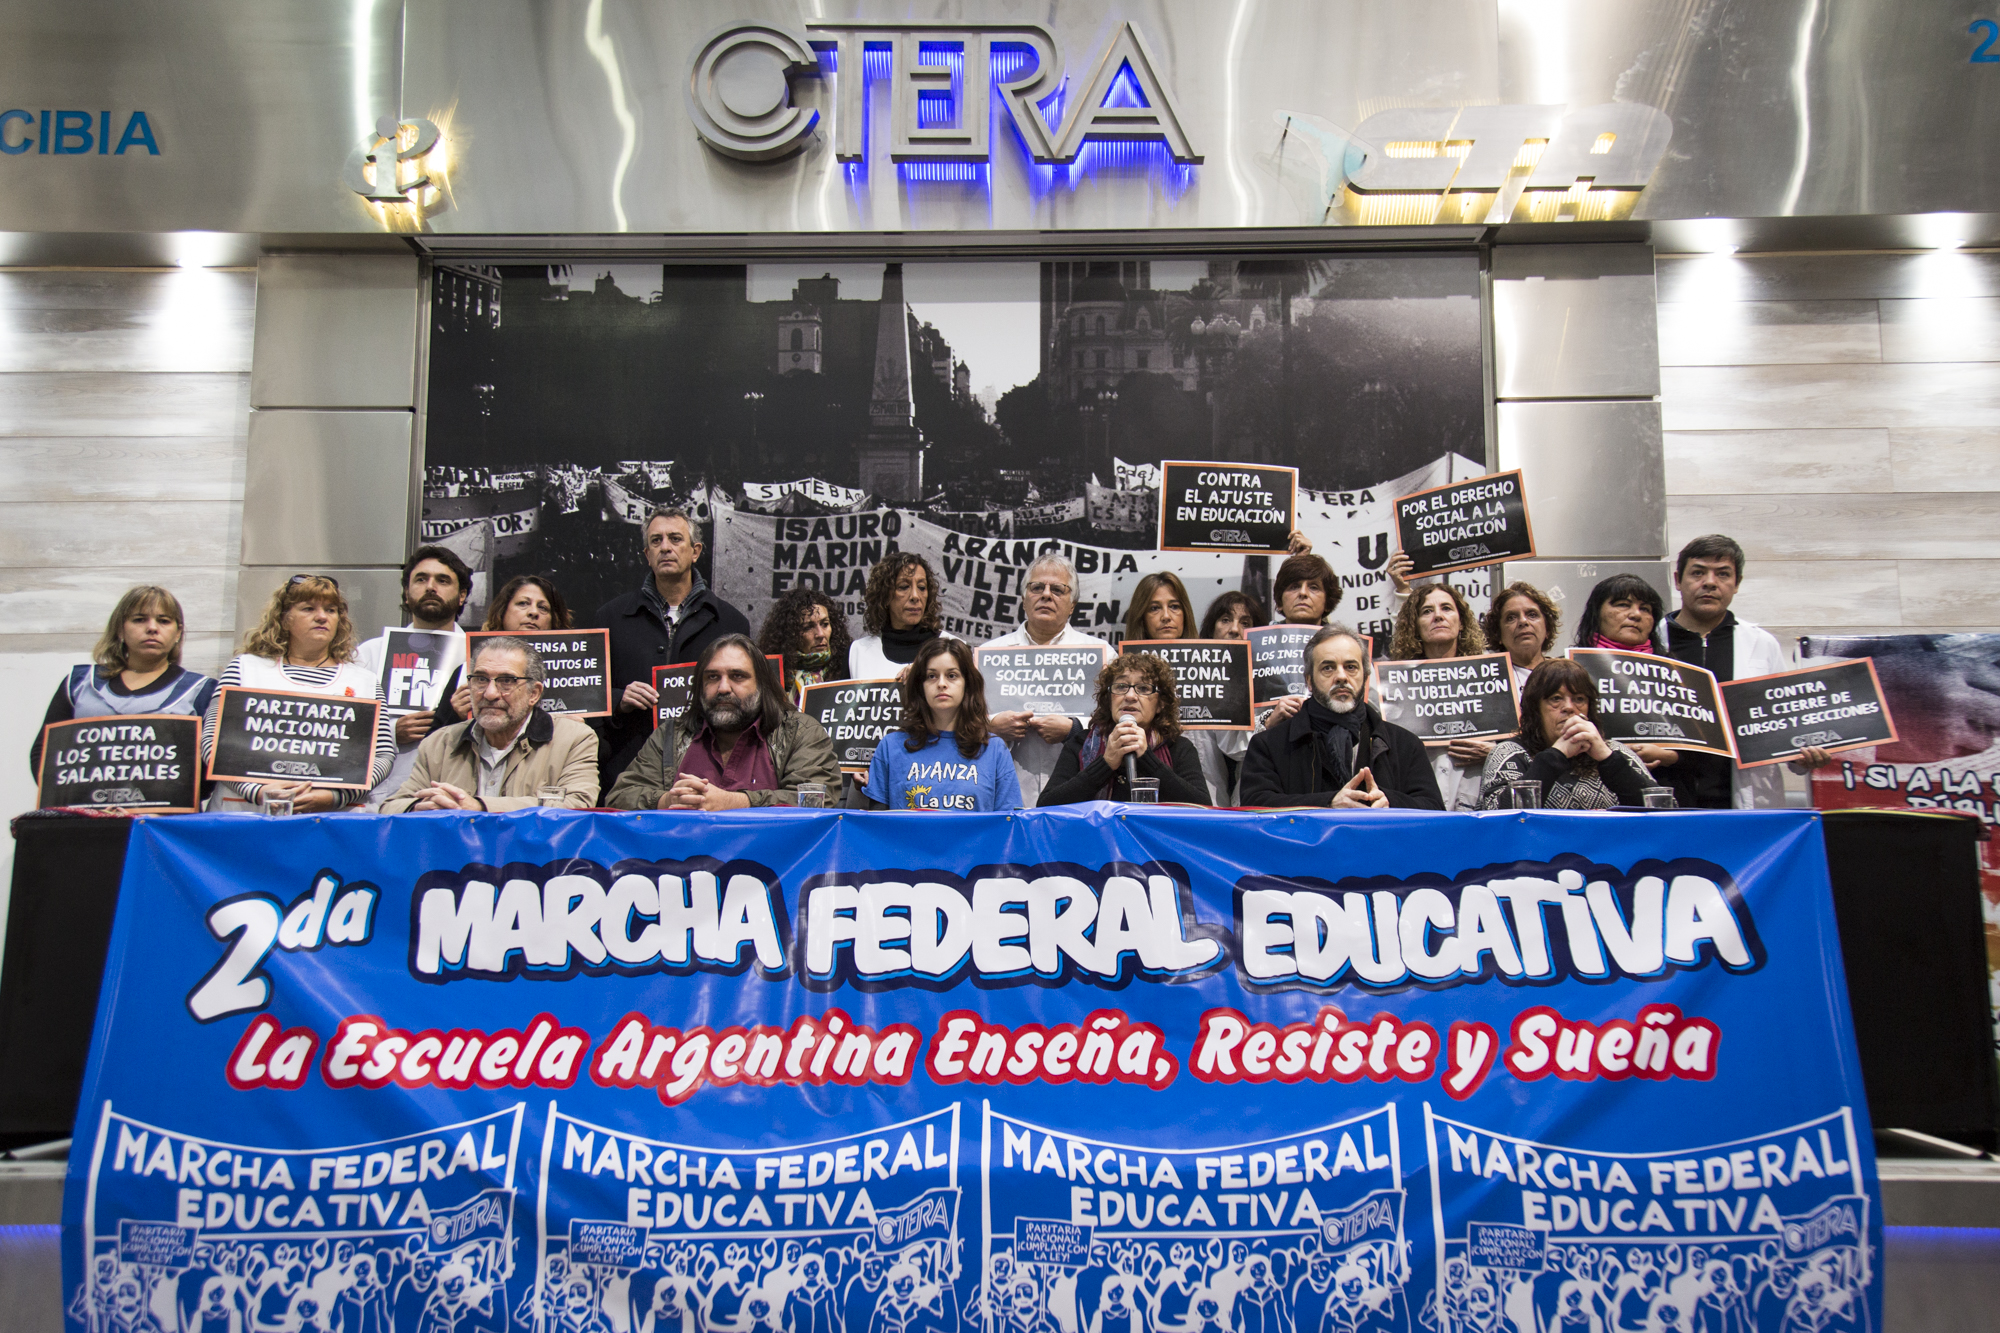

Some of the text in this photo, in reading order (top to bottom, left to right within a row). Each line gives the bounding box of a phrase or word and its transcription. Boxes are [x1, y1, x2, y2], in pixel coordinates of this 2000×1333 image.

[1969, 19, 2000, 63] 2
[690, 19, 1205, 164] CTERA
[760, 480, 855, 502] SUTEBA
[1197, 472, 1261, 488] CONTRA
[1185, 489, 1272, 506] EL AJUSTE
[1402, 480, 1514, 517] POR EL DERECHO
[1177, 506, 1285, 524] EN EDUCACIÓN
[1416, 501, 1506, 530] SOCIAL A LA
[775, 511, 902, 542] ISAURO
[1423, 517, 1507, 546] EDUCACIÓN
[1357, 532, 1389, 570] U
[1340, 570, 1387, 589] NION
[1356, 595, 1381, 611] DE
[572, 641, 587, 652] DE
[1262, 635, 1277, 645] EN
[393, 653, 429, 669] NO AL
[584, 658, 597, 669] DE
[983, 652, 1098, 667] POR EL DERECHO
[1256, 651, 1275, 662] LOS
[552, 675, 602, 688] DOCENTE
[663, 676, 685, 689] POR
[995, 669, 1086, 681] SOCIAL A LA
[1388, 663, 1499, 684] EN DEFENSA DE
[1611, 660, 1682, 683] CONTRA
[834, 688, 901, 704] CONTRA
[1000, 681, 1085, 697] EDUCACIÓN
[1385, 678, 1508, 701] LA JUBILACIÓN
[1598, 678, 1697, 703] EL AJUSTE
[1765, 681, 1826, 700] CONTRA
[245, 697, 356, 722] PARITARIA
[821, 709, 838, 723] EL
[1416, 699, 1482, 717] DOCENTE
[1620, 698, 1715, 724] EDUCACIÓN
[1749, 691, 1851, 719] EL CIERRE DE
[245, 716, 350, 740] NACIONAL
[1737, 702, 1880, 737] CURSOS Y SECCIONES
[76, 726, 156, 744] CONTRA
[56, 745, 177, 766] LOS TECHOS
[251, 737, 341, 758] DOCENTE
[56, 764, 181, 785] SALARIALES
[907, 761, 978, 785] AVANZA
[1864, 765, 1898, 789] SI
[1906, 767, 1932, 793] A
[1941, 768, 1982, 795] LA
[920, 794, 975, 810] La UES
[189, 869, 1751, 1021] 2da MARCHA FEDERAL EDUCATIVA
[233, 1011, 1713, 1099] La Escuela Argentina Enseña, Resiste y Sueña
[113, 1123, 506, 1191] MARCHA FEDERAL
[562, 1123, 948, 1190] MARCHA FEDERAL
[1003, 1122, 1390, 1190] MARCHA FEDERAL
[1446, 1124, 1850, 1195] MARCHA FEDERAL
[176, 1186, 432, 1229] EDUCATIVA
[627, 1186, 877, 1229] EDUCATIVA
[1070, 1185, 1324, 1229] EDUCATIVA
[1522, 1189, 1786, 1233] EDUCATIVA
[430, 1196, 505, 1245] CTERA
[877, 1196, 949, 1245] CTERA
[1026, 1222, 1081, 1235] ¡PARITARIA
[1323, 1198, 1395, 1246] CTERA
[1784, 1203, 1859, 1252] CTERA
[1018, 1241, 1087, 1254] ¡CUMPLAN CON
[1026, 1233, 1080, 1245] NACIONAL!
[588, 1253, 601, 1262] LA
[1034, 1251, 1070, 1262] LA LEY!
